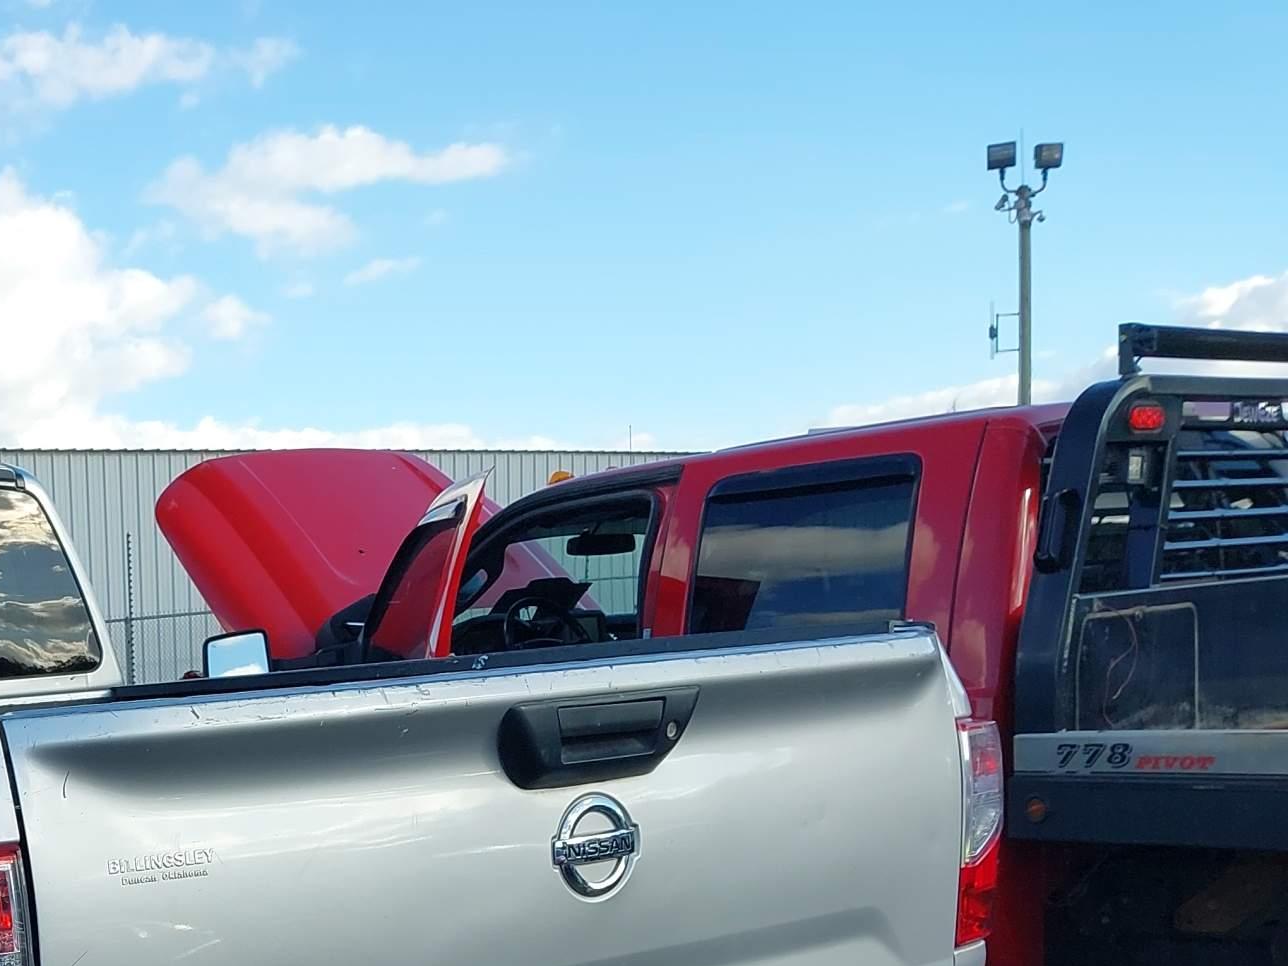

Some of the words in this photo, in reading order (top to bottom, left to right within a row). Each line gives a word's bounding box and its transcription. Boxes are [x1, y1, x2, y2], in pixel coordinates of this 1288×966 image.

[1057, 743, 1133, 769] 778
[1134, 754, 1217, 770] PIVOT
[567, 833, 632, 860] NISSAN
[107, 848, 214, 875] BILLINGSLEY
